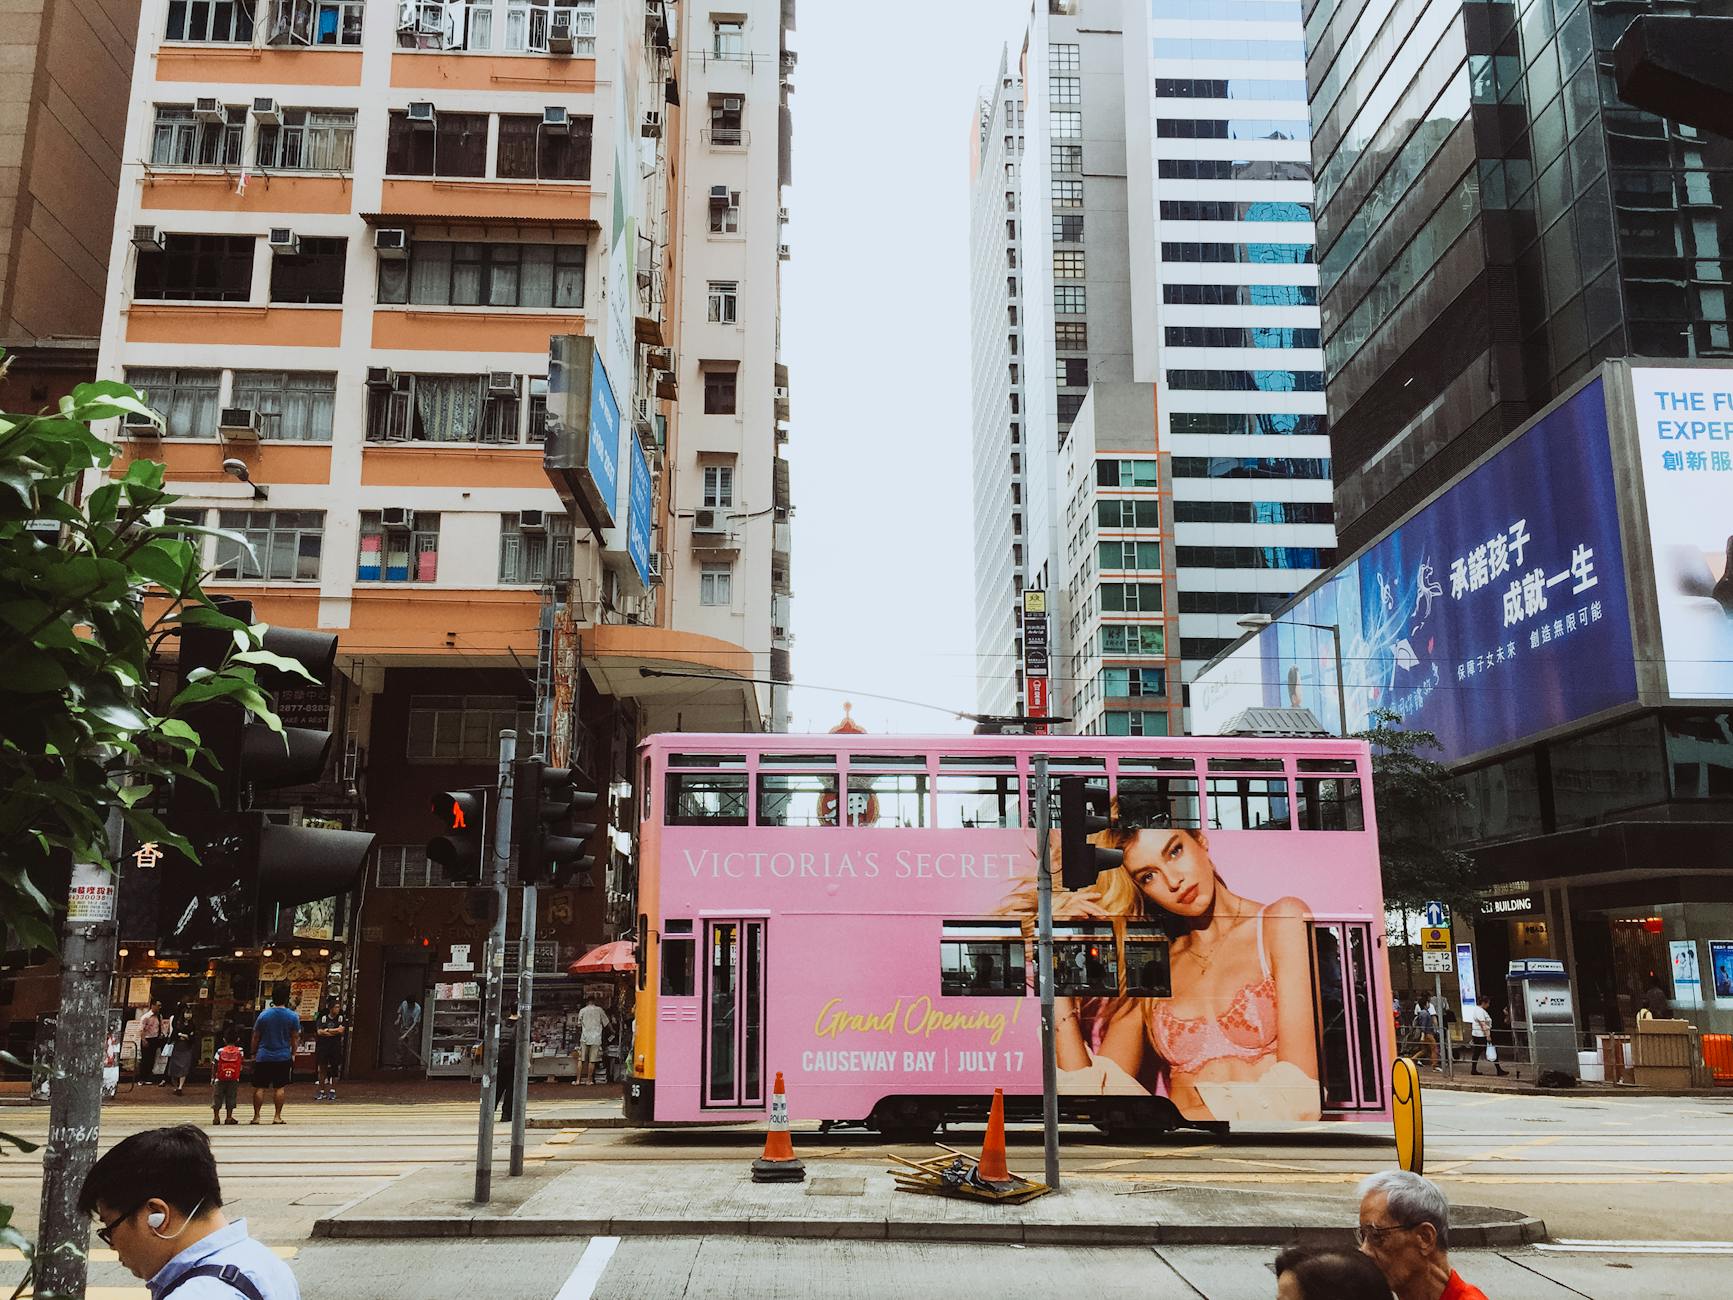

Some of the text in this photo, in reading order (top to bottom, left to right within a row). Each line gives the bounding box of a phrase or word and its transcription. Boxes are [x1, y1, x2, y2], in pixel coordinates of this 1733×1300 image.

[1654, 391, 1706, 411] THE
[1450, 518, 1531, 601] 承諾孩子
[1503, 543, 1599, 629] 成就一生
[1457, 600, 1604, 682] 保障子女未來 創造無限可能
[131, 841, 164, 869] 香
[683, 848, 1022, 879] VICTORIA'S SECRET
[1494, 898, 1532, 913] BUILDING
[1441, 953, 1450, 961] 12
[1442, 964, 1451, 972] 12
[814, 994, 1024, 1046] Grand Opening!
[801, 1051, 1025, 1073] CAUSEWAY BAY JULY 17
[631, 1084, 641, 1097] 35
